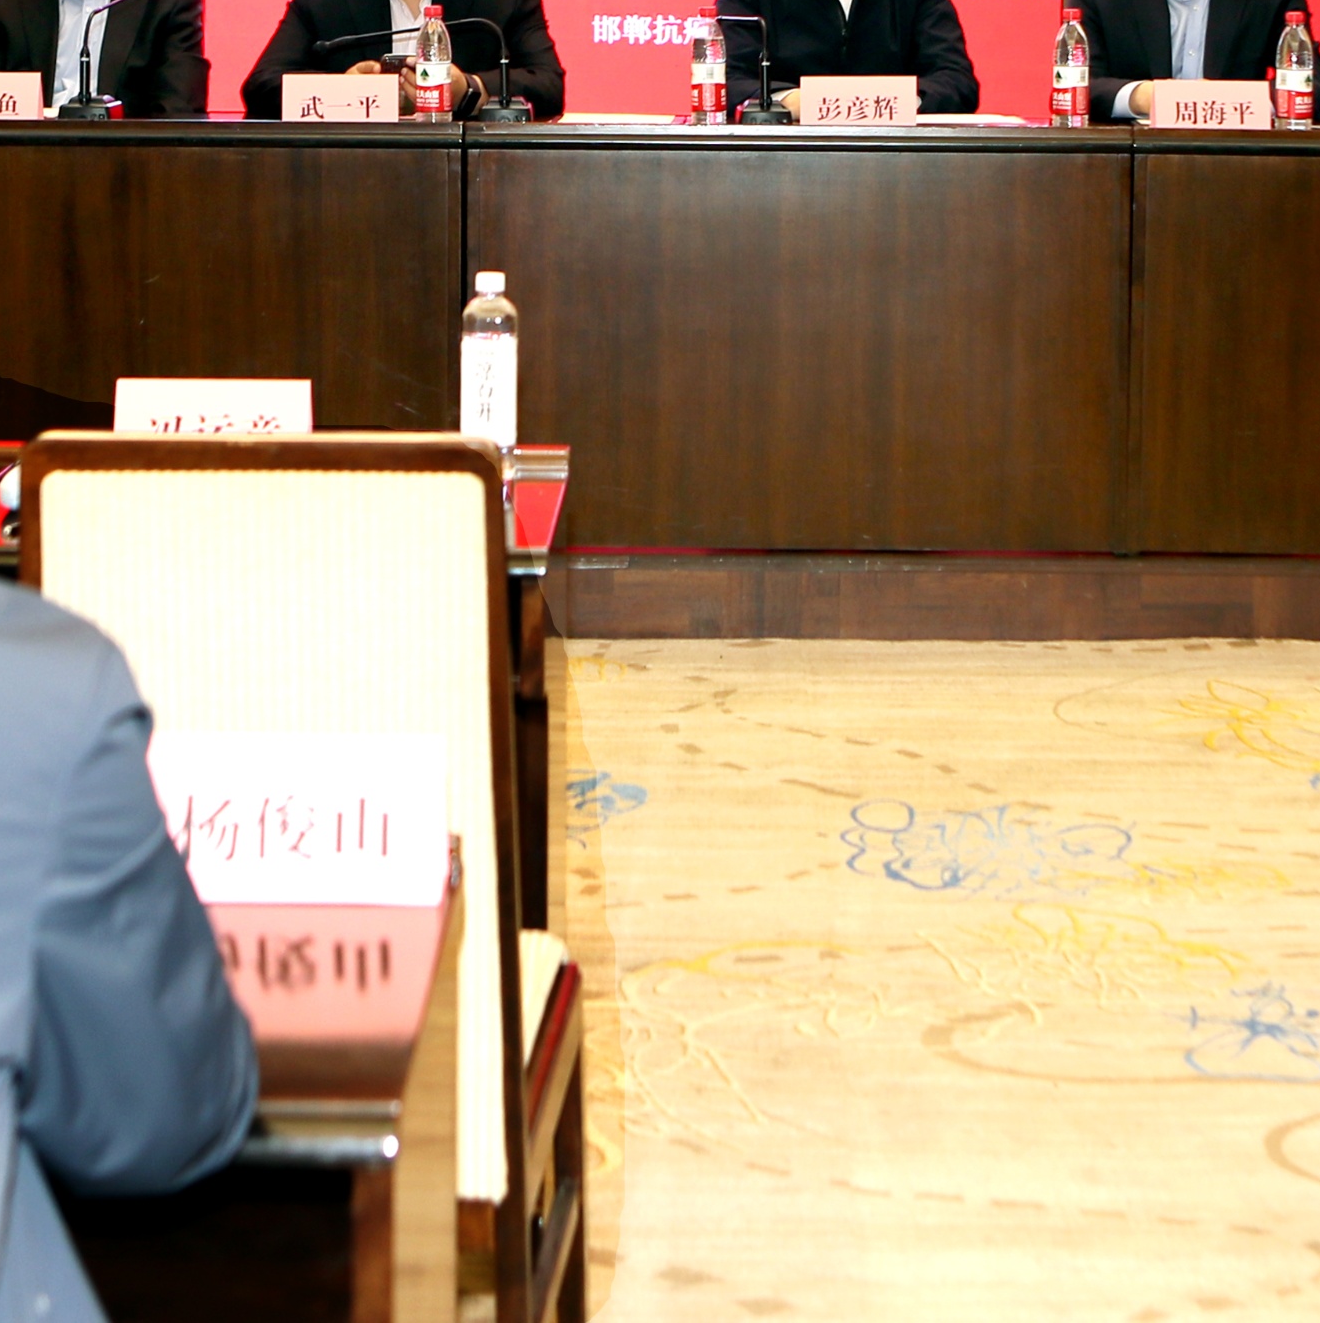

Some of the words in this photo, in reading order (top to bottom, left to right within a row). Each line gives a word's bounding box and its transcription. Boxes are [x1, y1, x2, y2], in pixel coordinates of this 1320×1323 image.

[299, 94, 381, 120] 武一平
[817, 95, 899, 122] 彭彦辉
[1174, 99, 1256, 126] 周海平
